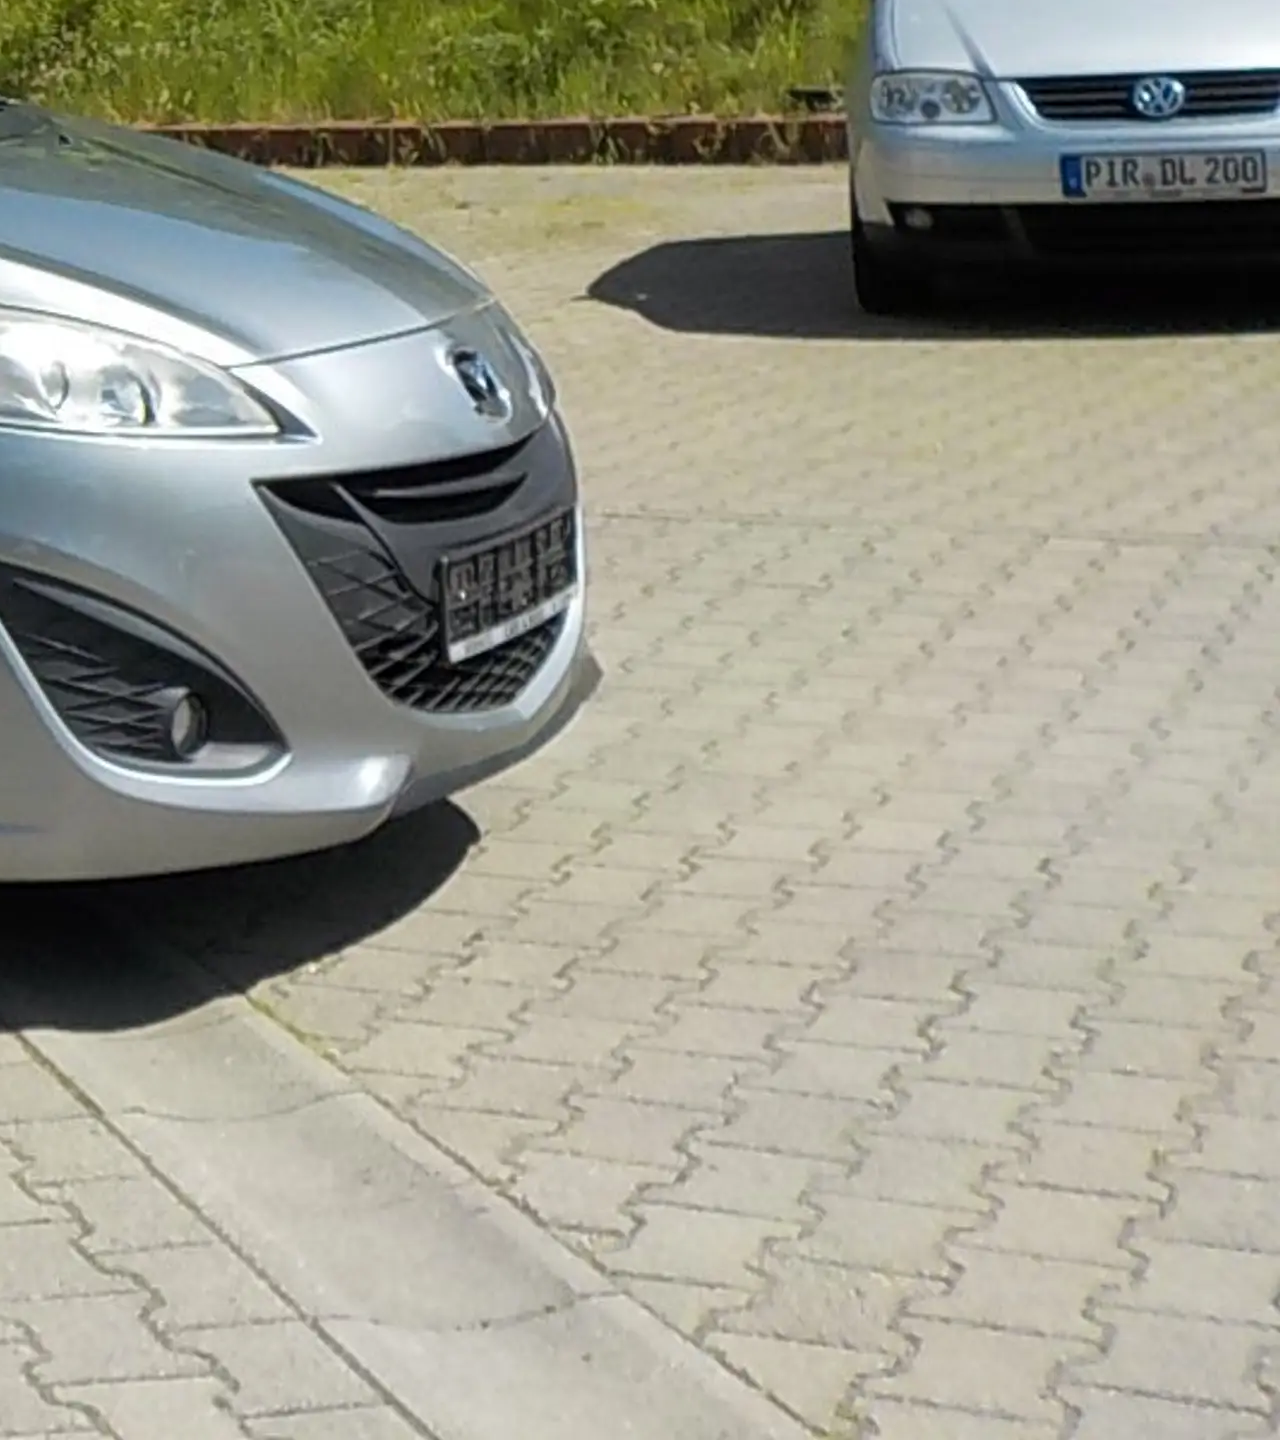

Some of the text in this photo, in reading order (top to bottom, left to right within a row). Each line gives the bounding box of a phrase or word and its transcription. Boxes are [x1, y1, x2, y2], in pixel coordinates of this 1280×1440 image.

[1085, 156, 1258, 187] PIR DL 200
